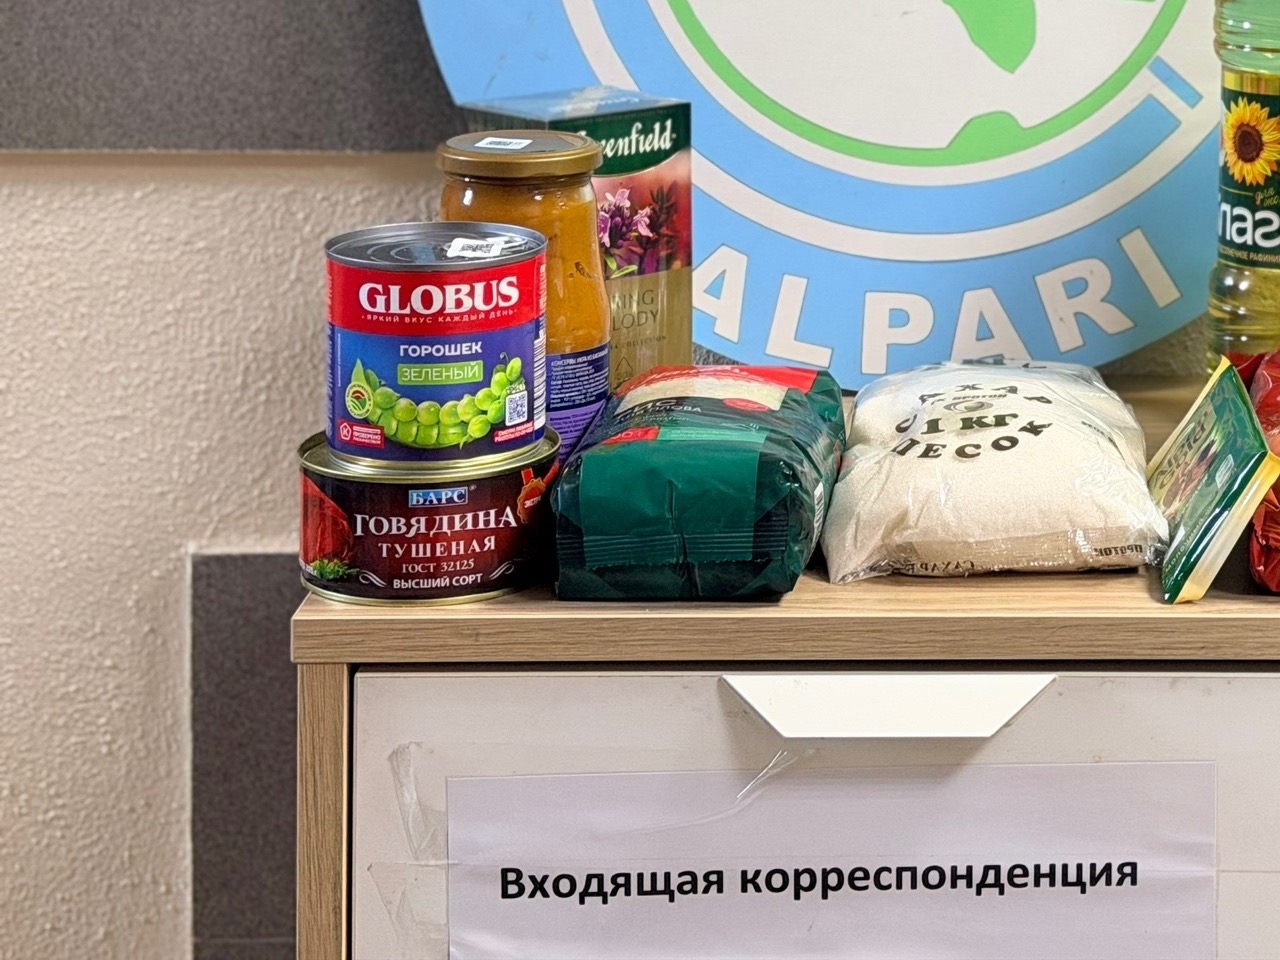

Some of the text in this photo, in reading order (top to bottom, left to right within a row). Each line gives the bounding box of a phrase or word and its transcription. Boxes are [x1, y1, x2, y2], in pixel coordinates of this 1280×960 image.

[359, 275, 520, 315] GLOBUS
[691, 227, 1182, 376] ALPARI
[366, 310, 514, 324] ЯРКИЙ ВКУС КАЖДЫЙ ДЕНЬ
[612, 309, 659, 332] LODY
[399, 341, 483, 358] ГОРОШЕК
[401, 362, 480, 382] ЗЕЛЕНЫЙ
[891, 419, 1054, 459] ПЕСОК
[411, 489, 466, 506] БАРС
[353, 505, 518, 538] ГОВЯДИНА
[378, 535, 496, 558] ТУШЕНАЯ
[402, 558, 475, 574] ГОСТ 32125
[393, 572, 483, 590] ВЫСШИЙ СОРТ
[499, 860, 1139, 906] Входящая корреспонденция
